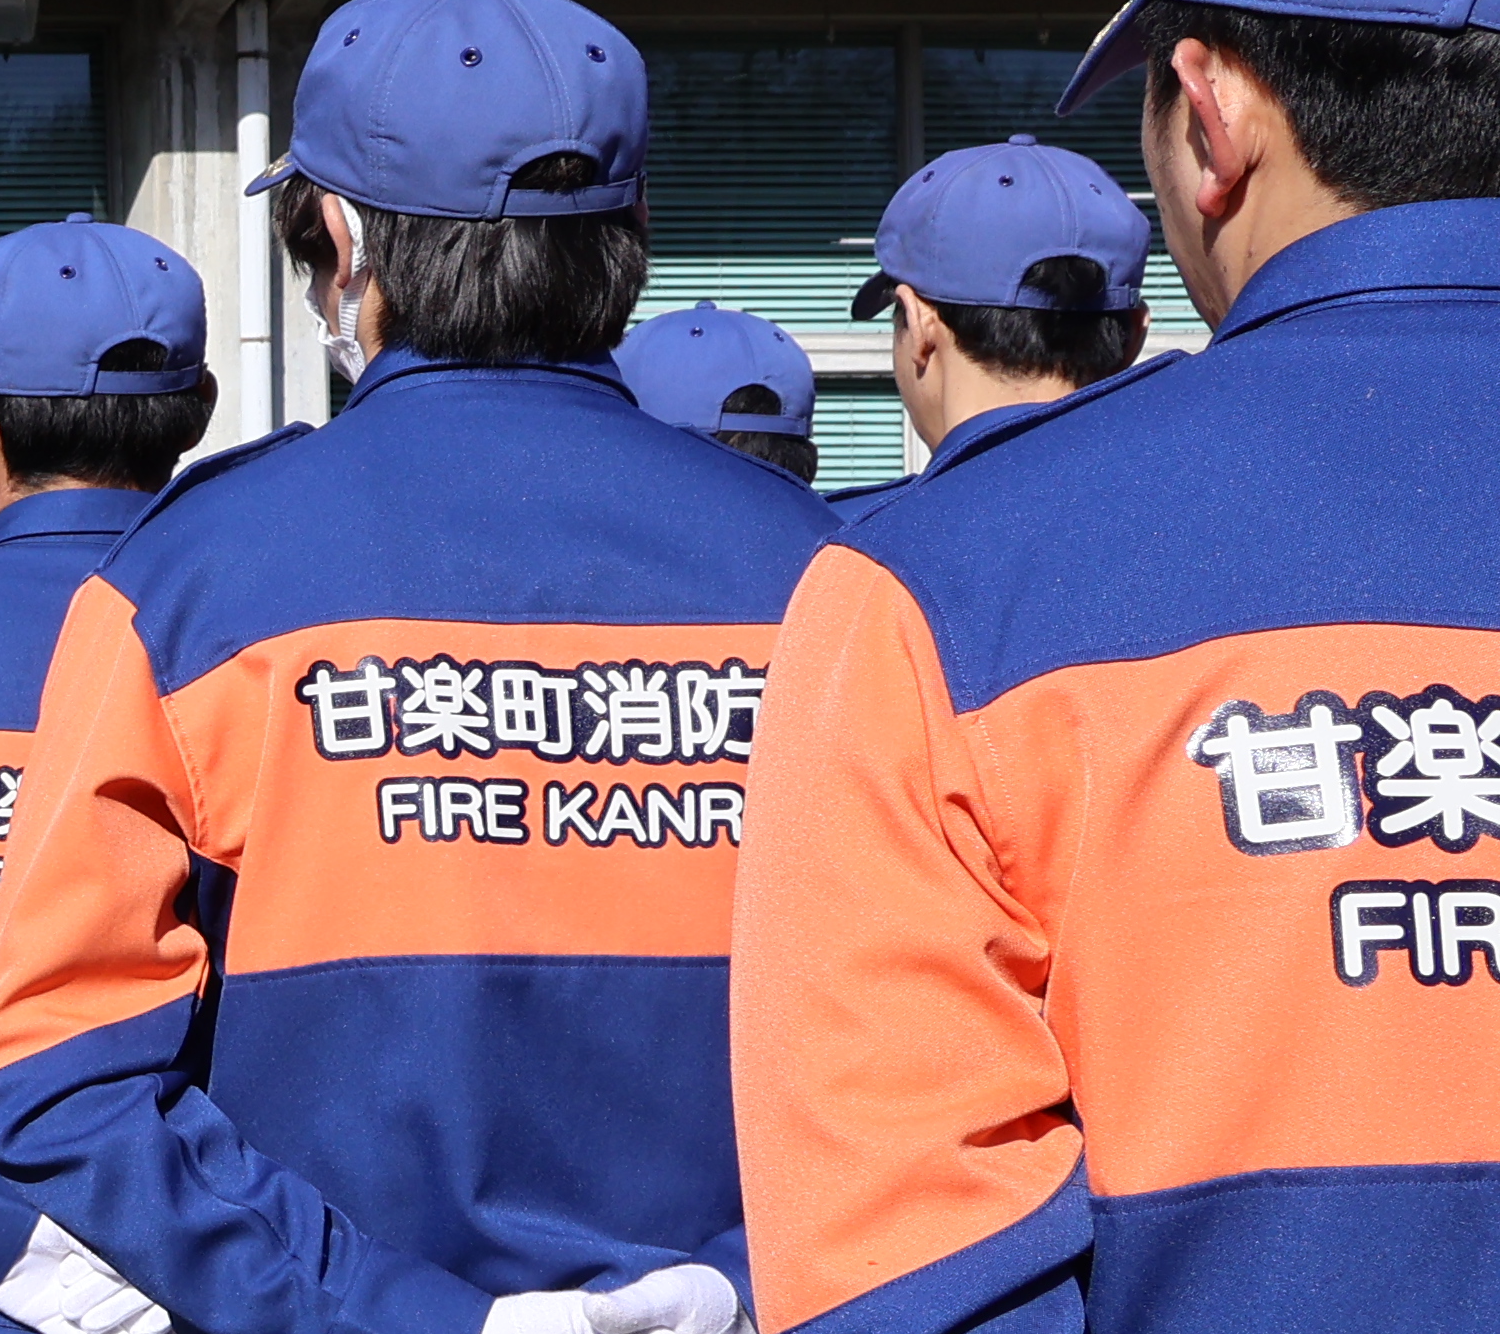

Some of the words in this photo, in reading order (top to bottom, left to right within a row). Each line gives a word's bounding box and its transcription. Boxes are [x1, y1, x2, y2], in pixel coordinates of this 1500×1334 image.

[302, 661, 766, 757] 甘楽町消防
[381, 782, 524, 839] FIRE
[549, 787, 743, 843] KANR
[1202, 697, 1500, 843] 甘楽
[1340, 891, 1500, 978] FIR
